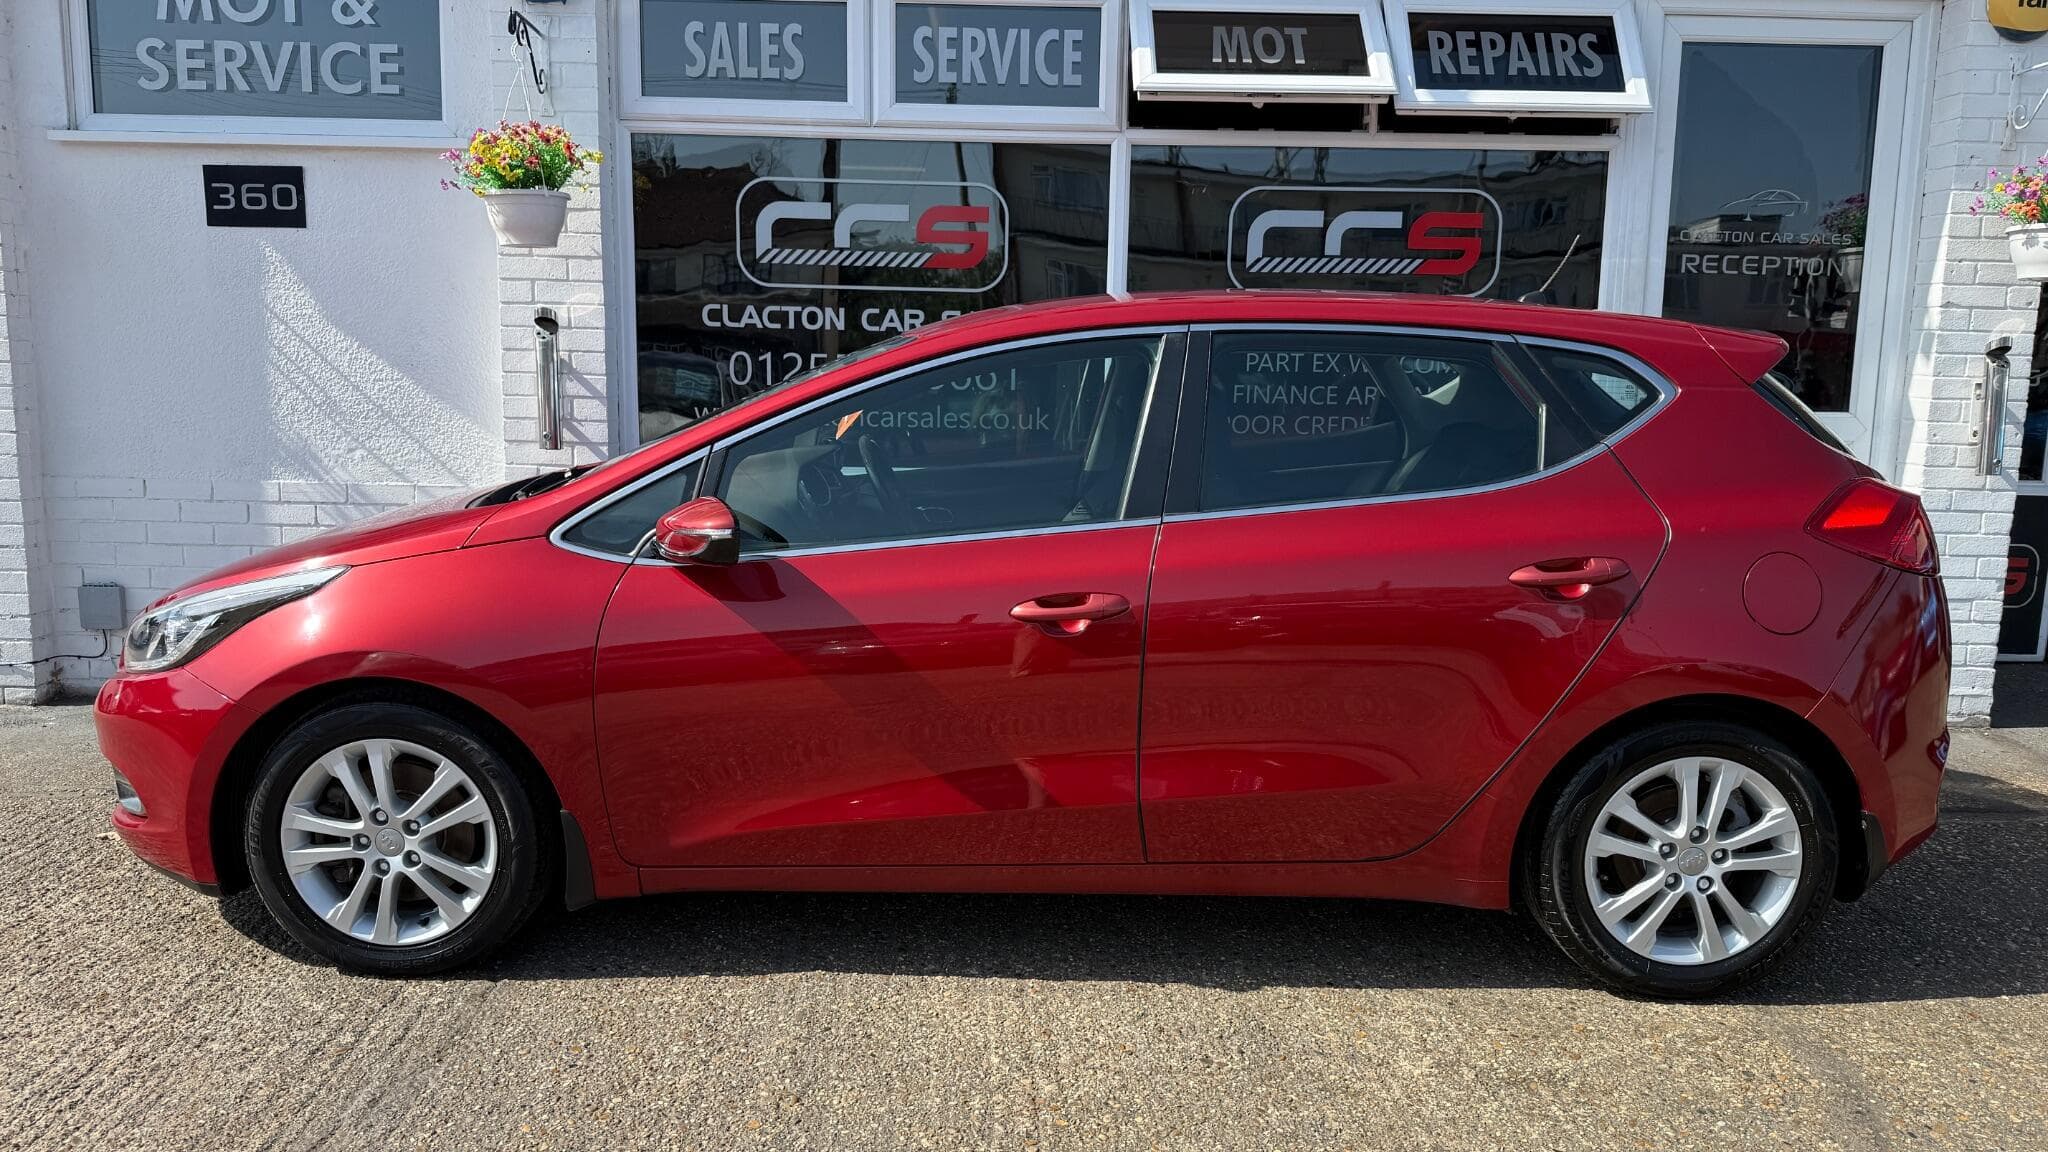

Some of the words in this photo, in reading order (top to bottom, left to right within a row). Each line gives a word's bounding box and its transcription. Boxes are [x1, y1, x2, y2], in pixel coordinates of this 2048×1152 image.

[684, 21, 804, 80] SALES
[913, 25, 1083, 87] SERVICE
[1212, 26, 1307, 65] MOT
[1428, 30, 1604, 78] REPAIRS
[136, 38, 400, 94] SERVICE
[211, 183, 298, 210] 360
[1760, 232, 1794, 244] CAR
[1799, 232, 1852, 245] SALES
[1681, 254, 1844, 277] RECEPTION
[702, 304, 845, 331] CLACTON
[861, 308, 925, 332] CAR
[729, 350, 845, 386] 012
[1246, 353, 1304, 373] PART
[1312, 354, 1340, 373] EX
[1233, 385, 1338, 405] FINANCE
[1226, 415, 1286, 434] OOR
